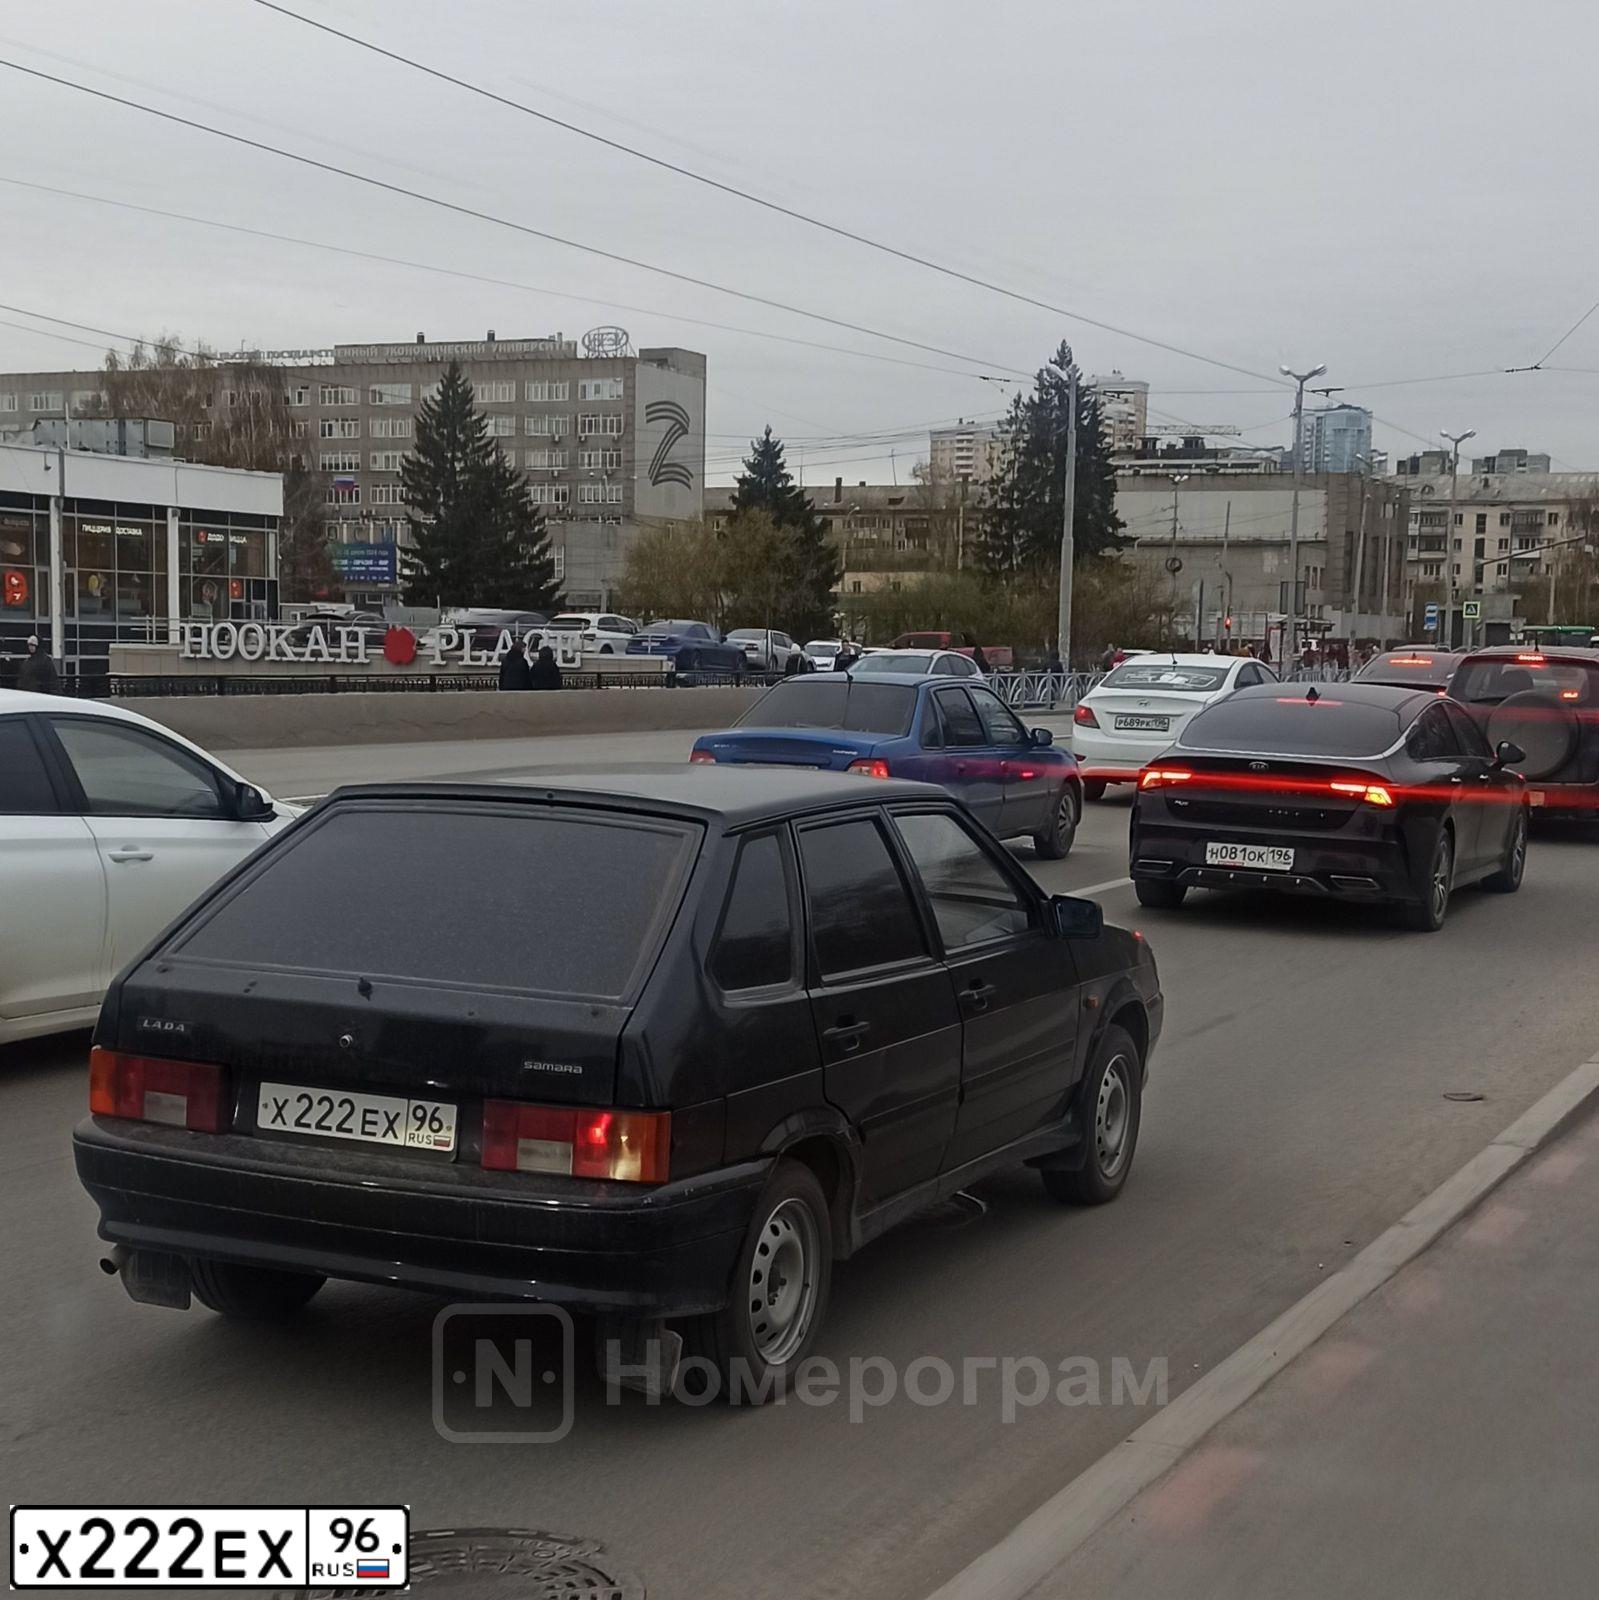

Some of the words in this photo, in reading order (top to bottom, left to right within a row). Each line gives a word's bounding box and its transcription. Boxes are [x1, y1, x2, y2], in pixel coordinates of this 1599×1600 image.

[385, 342, 485, 356] ЭКОНОМИЧЕСКИЙ
[493, 340, 575, 353] УНИВЕРСИТЕТ
[180, 622, 370, 664] HOOKAH
[1210, 845, 1266, 863] Н081ОК
[1269, 849, 1290, 861] 196
[143, 1019, 185, 1032] LADA
[270, 1093, 401, 1139] Х222ЕХ
[412, 1104, 444, 1133] 96
[408, 1132, 432, 1145] RUS
